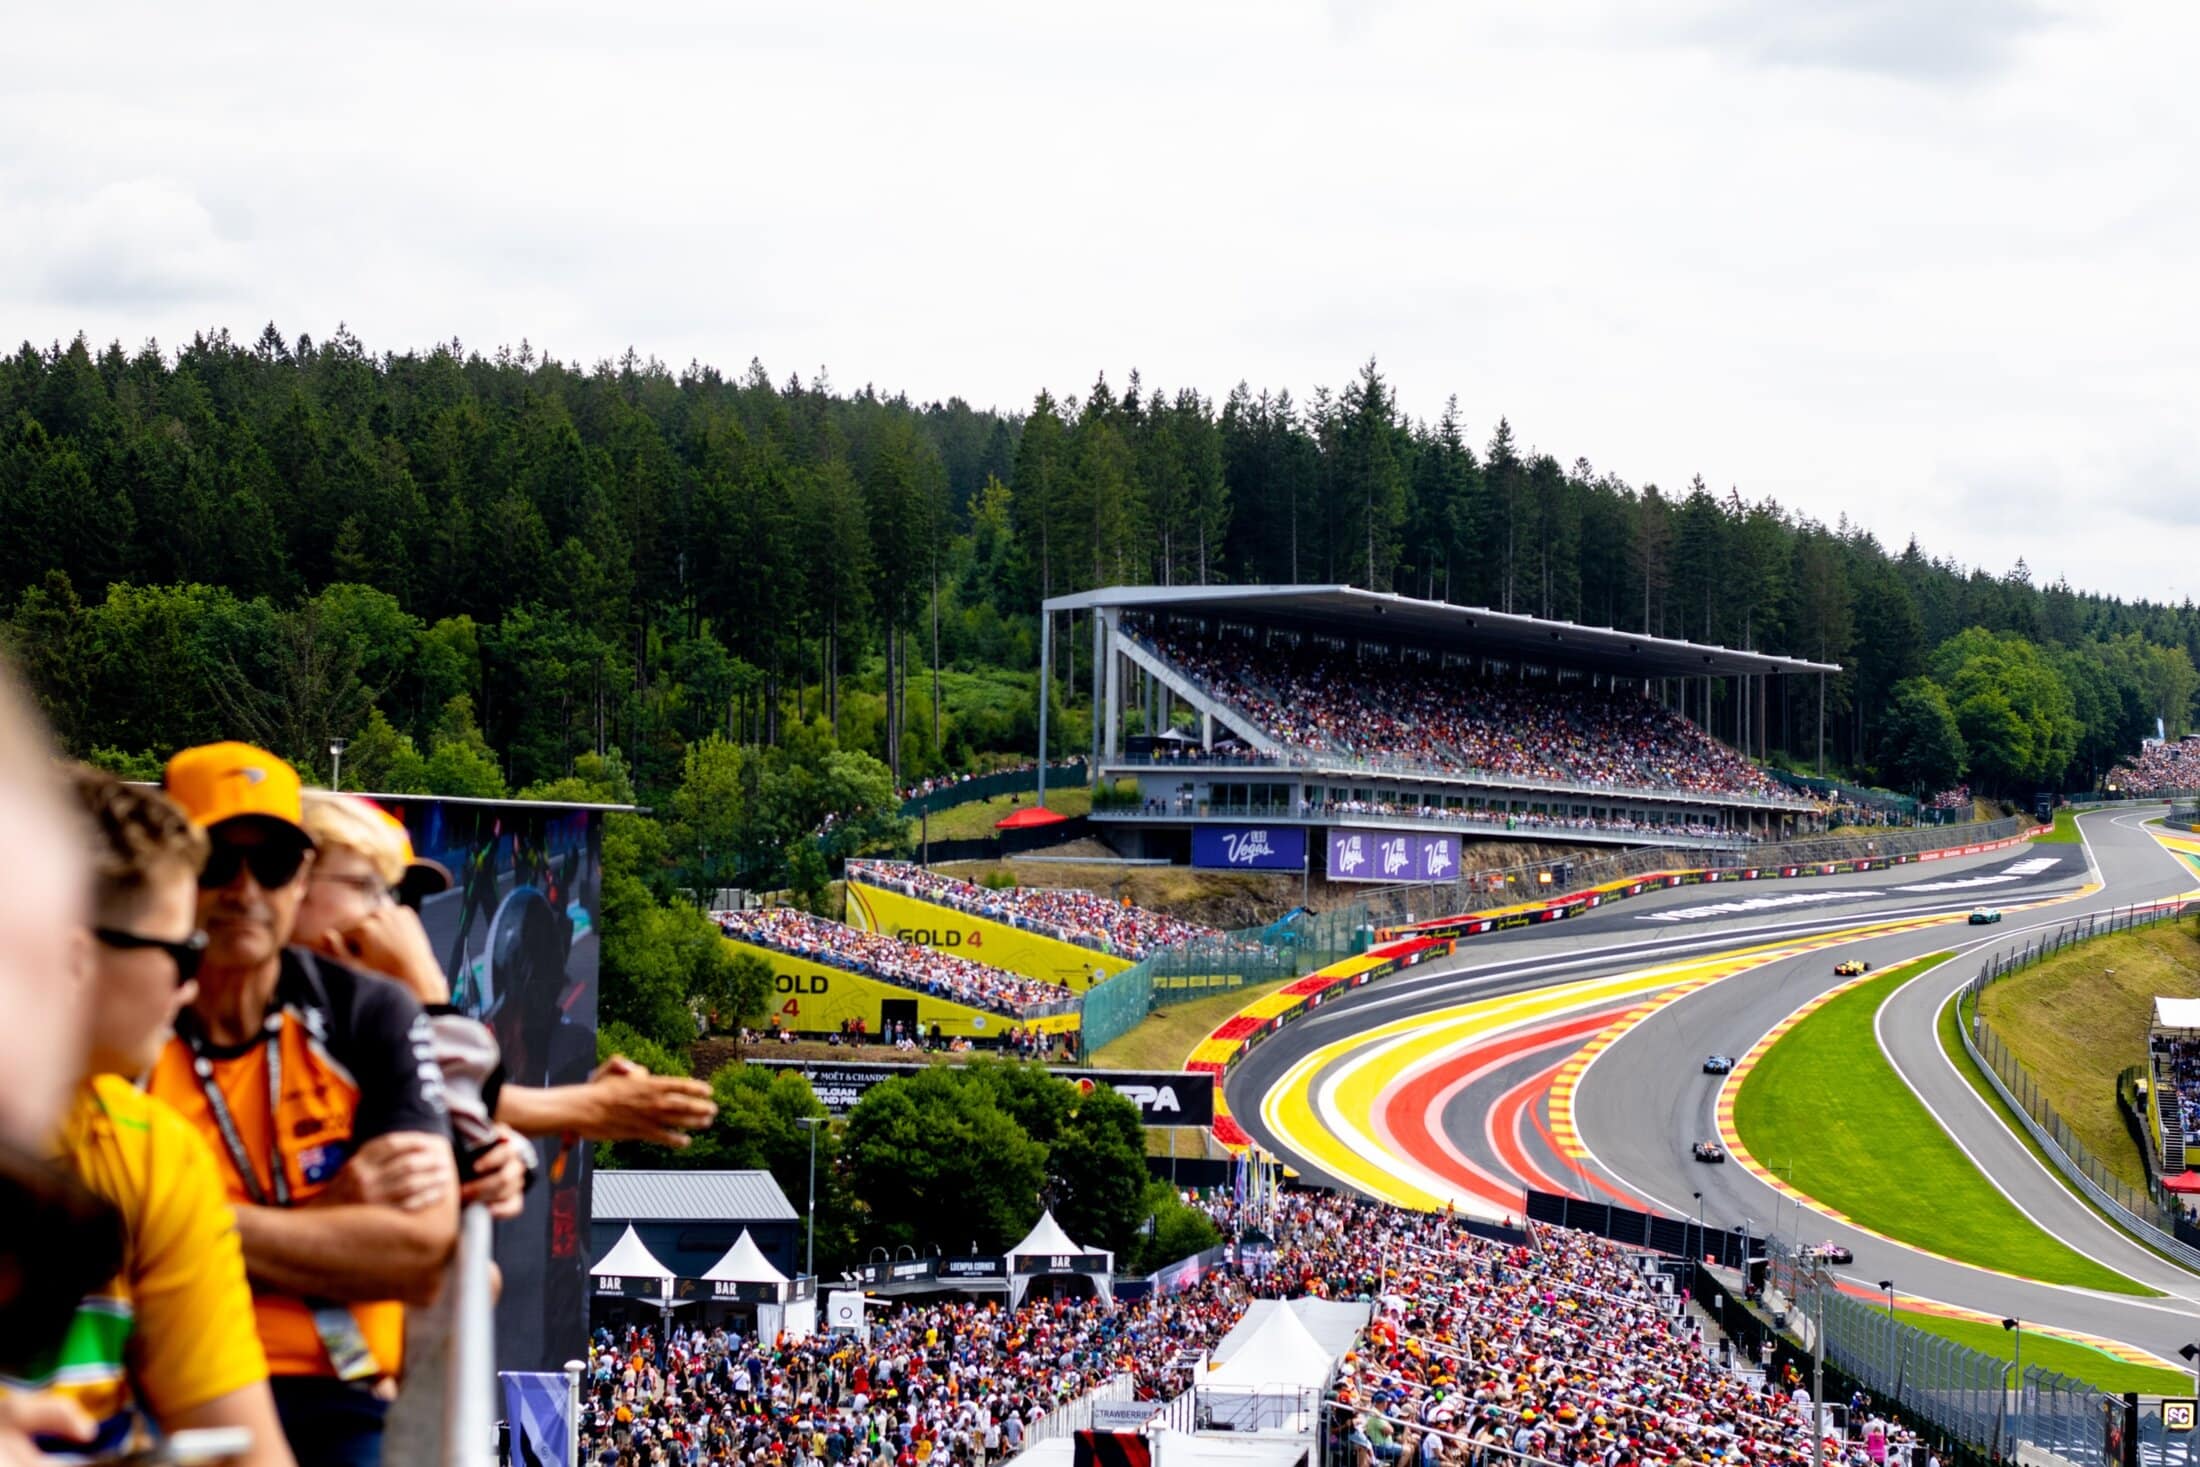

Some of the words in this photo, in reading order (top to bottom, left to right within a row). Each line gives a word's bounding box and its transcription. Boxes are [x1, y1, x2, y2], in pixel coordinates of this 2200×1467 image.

[1222, 831, 1275, 865] Vegas
[897, 929, 961, 947] GOLD
[966, 930, 983, 948] 4
[775, 974, 829, 994] OLD
[782, 998, 800, 1017] 4
[820, 1072, 845, 1081] MOËT
[1051, 1255, 1071, 1268] BAR
[600, 1276, 621, 1290] BAR
[715, 1281, 737, 1296] BAR
[2168, 1408, 2189, 1423] SC
